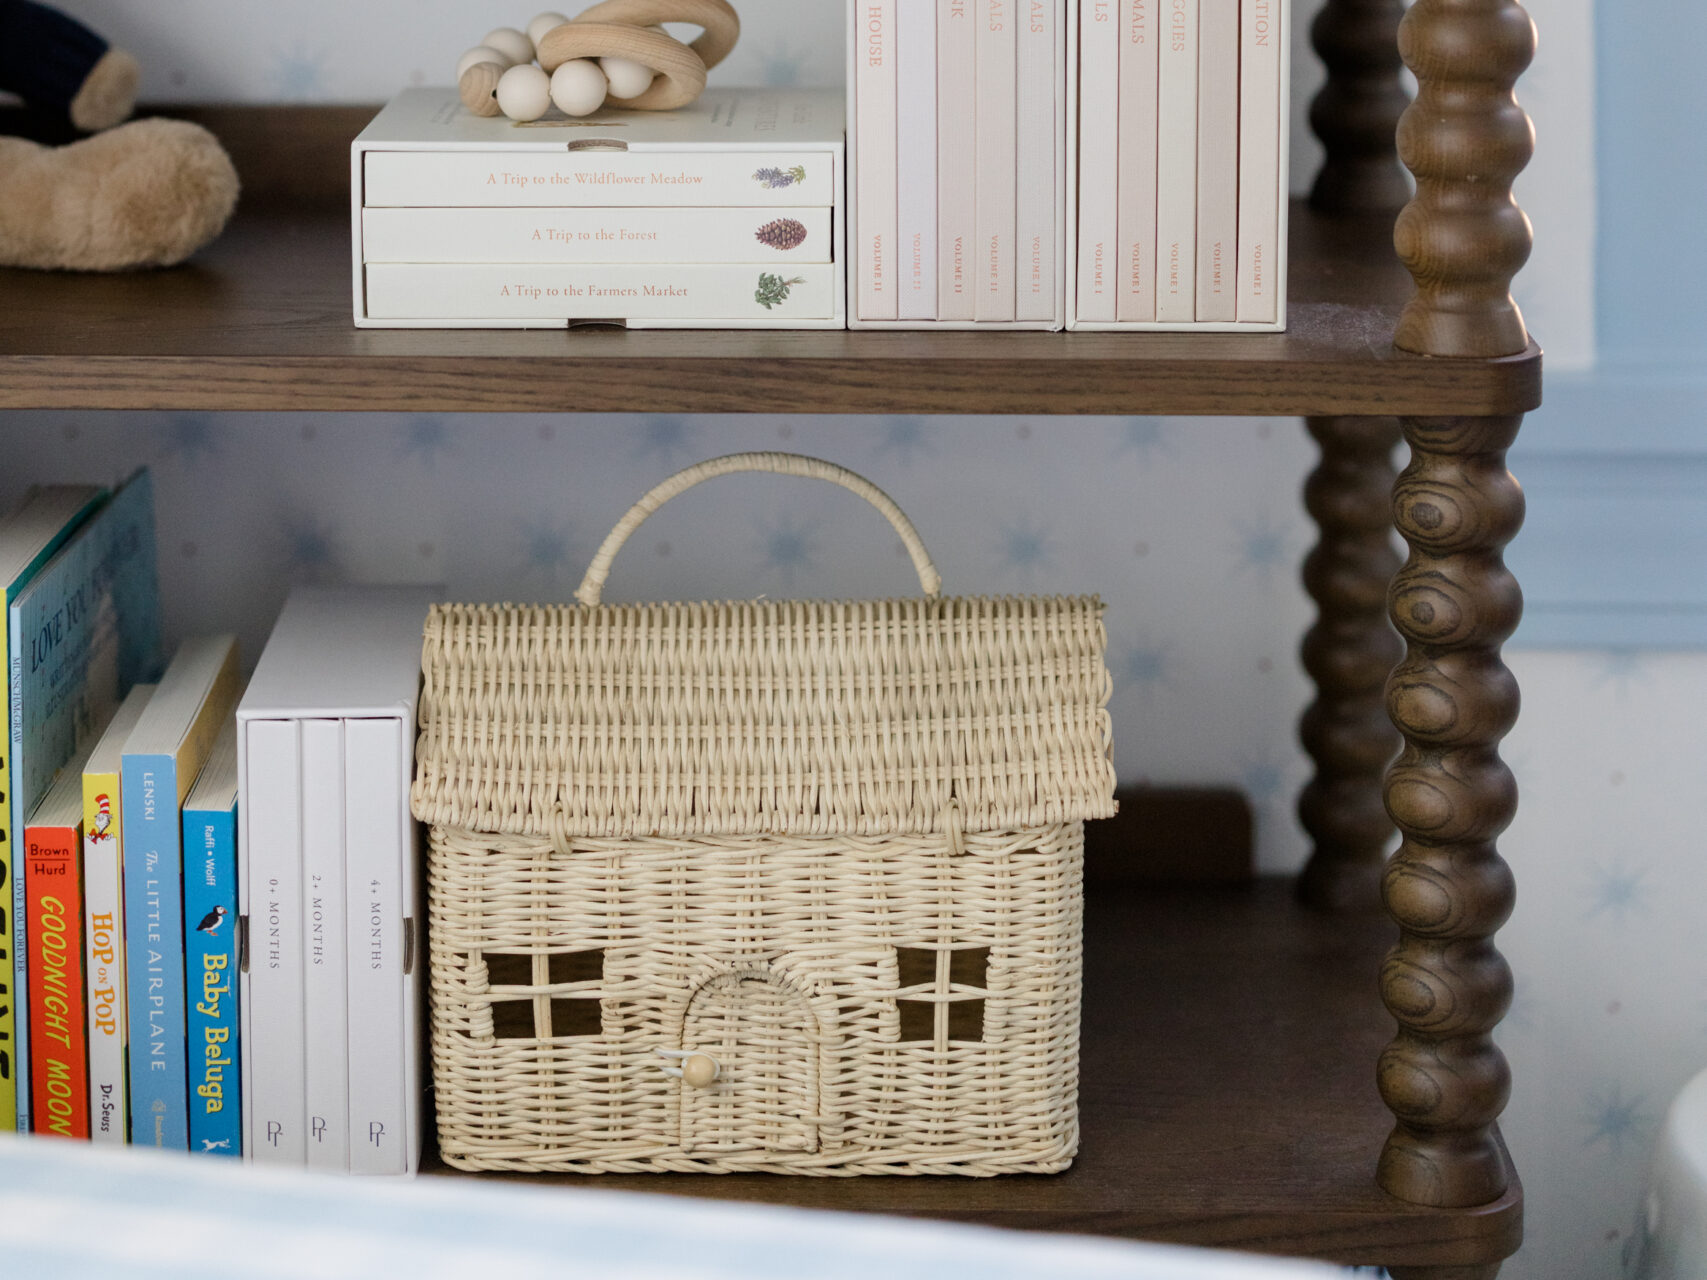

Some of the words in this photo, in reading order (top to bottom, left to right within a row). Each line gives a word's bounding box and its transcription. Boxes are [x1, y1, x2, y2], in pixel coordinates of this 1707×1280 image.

[868, 6, 882, 67] HOUSE
[486, 173, 497, 185] A
[501, 173, 528, 188] Trip
[533, 175, 545, 185] to
[550, 172, 570, 185] the
[574, 172, 646, 185] Wildflower
[650, 172, 704, 185] Meadow
[531, 229, 542, 241] A
[546, 229, 573, 244] Trip
[578, 231, 590, 241] to
[595, 228, 615, 241] the
[619, 229, 658, 241] Forest
[873, 235, 882, 279] VOLUME
[912, 233, 921, 277] VOLUME
[954, 236, 962, 280] VOLUME
[990, 235, 998, 279] VOLUME
[1032, 236, 1040, 280] VOLUME
[1095, 243, 1103, 286] VOLUME
[1132, 242, 1140, 287] VOLUME
[1170, 243, 1179, 286] VOLUME
[1213, 242, 1221, 286] VOLUME
[1253, 244, 1262, 288] VOLUME
[500, 285, 511, 297] A
[514, 285, 542, 300] Trip
[546, 287, 559, 297] to
[563, 284, 584, 297] the
[588, 285, 638, 297] Farmers
[643, 284, 689, 297] Market
[31, 609, 63, 673] LOVE
[143, 773, 155, 820] LENSKI
[30, 844, 69, 856] Brown
[205, 825, 215, 848] Raffi
[34, 864, 66, 875] Hurd
[145, 850, 158, 872] The
[205, 858, 216, 886] Wolff
[312, 875, 321, 888] 2+
[16, 878, 24, 903] LOVE
[269, 879, 278, 894] 0+
[370, 880, 381, 894] 4+
[16, 905, 25, 926] YOU
[147, 880, 160, 942] LITTLE
[313, 898, 323, 965] MONTHS
[16, 928, 25, 972] FOREVER
[92, 912, 115, 964] HOP
[269, 902, 280, 969] MONTHS
[371, 902, 382, 969] MONTHS
[40, 896, 72, 1049] GOODNIGHT
[196, 953, 228, 1018] Baby
[94, 985, 117, 1036] POP
[148, 950, 165, 1071] AIRPLANE
[197, 1026, 231, 1114] Beluga
[46, 1058, 73, 1137] MOON
